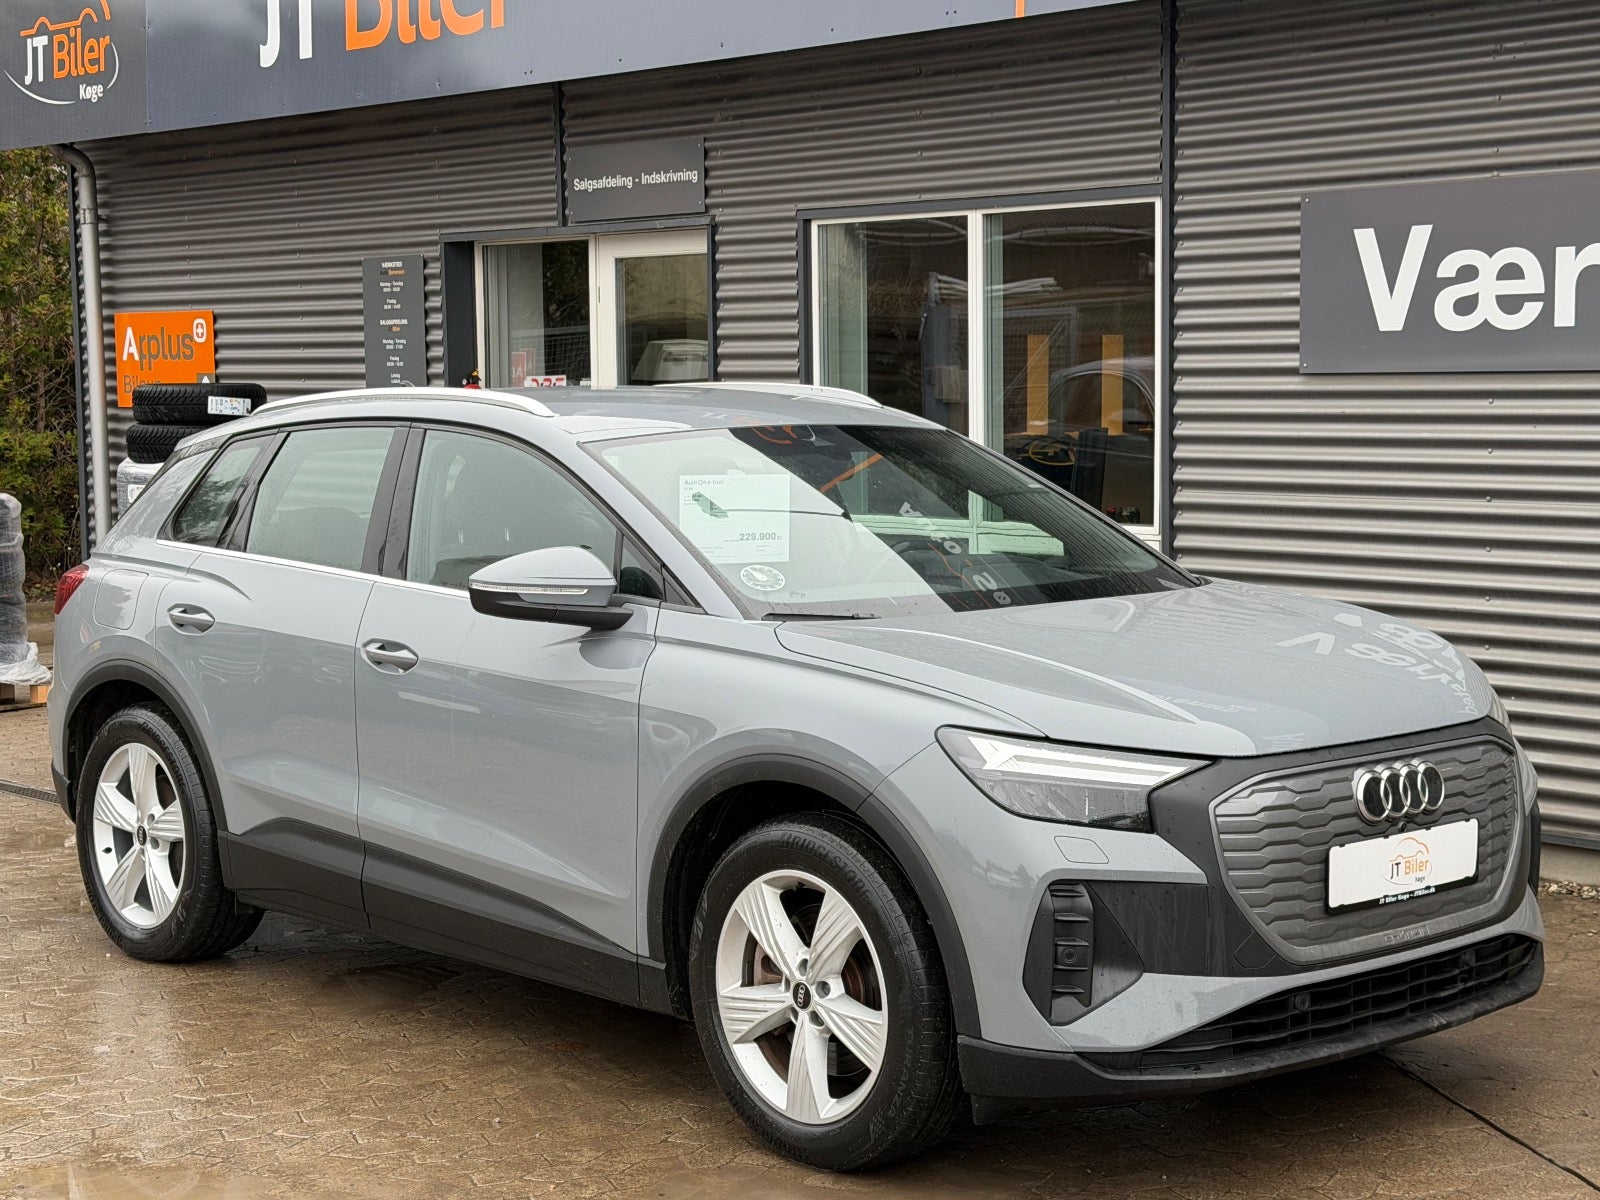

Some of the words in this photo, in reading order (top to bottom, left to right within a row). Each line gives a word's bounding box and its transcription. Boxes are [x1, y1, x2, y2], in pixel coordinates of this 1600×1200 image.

[24, 35, 48, 85] JT
[53, 27, 110, 79] Biler
[79, 84, 104, 103] Køge
[573, 174, 633, 192] Salgsafdeling
[641, 168, 698, 184] Indskrivning
[1353, 224, 1600, 332] Vær
[739, 532, 776, 541] 229.900
[1390, 862, 1401, 880] JT
[1404, 858, 1429, 875] Biler
